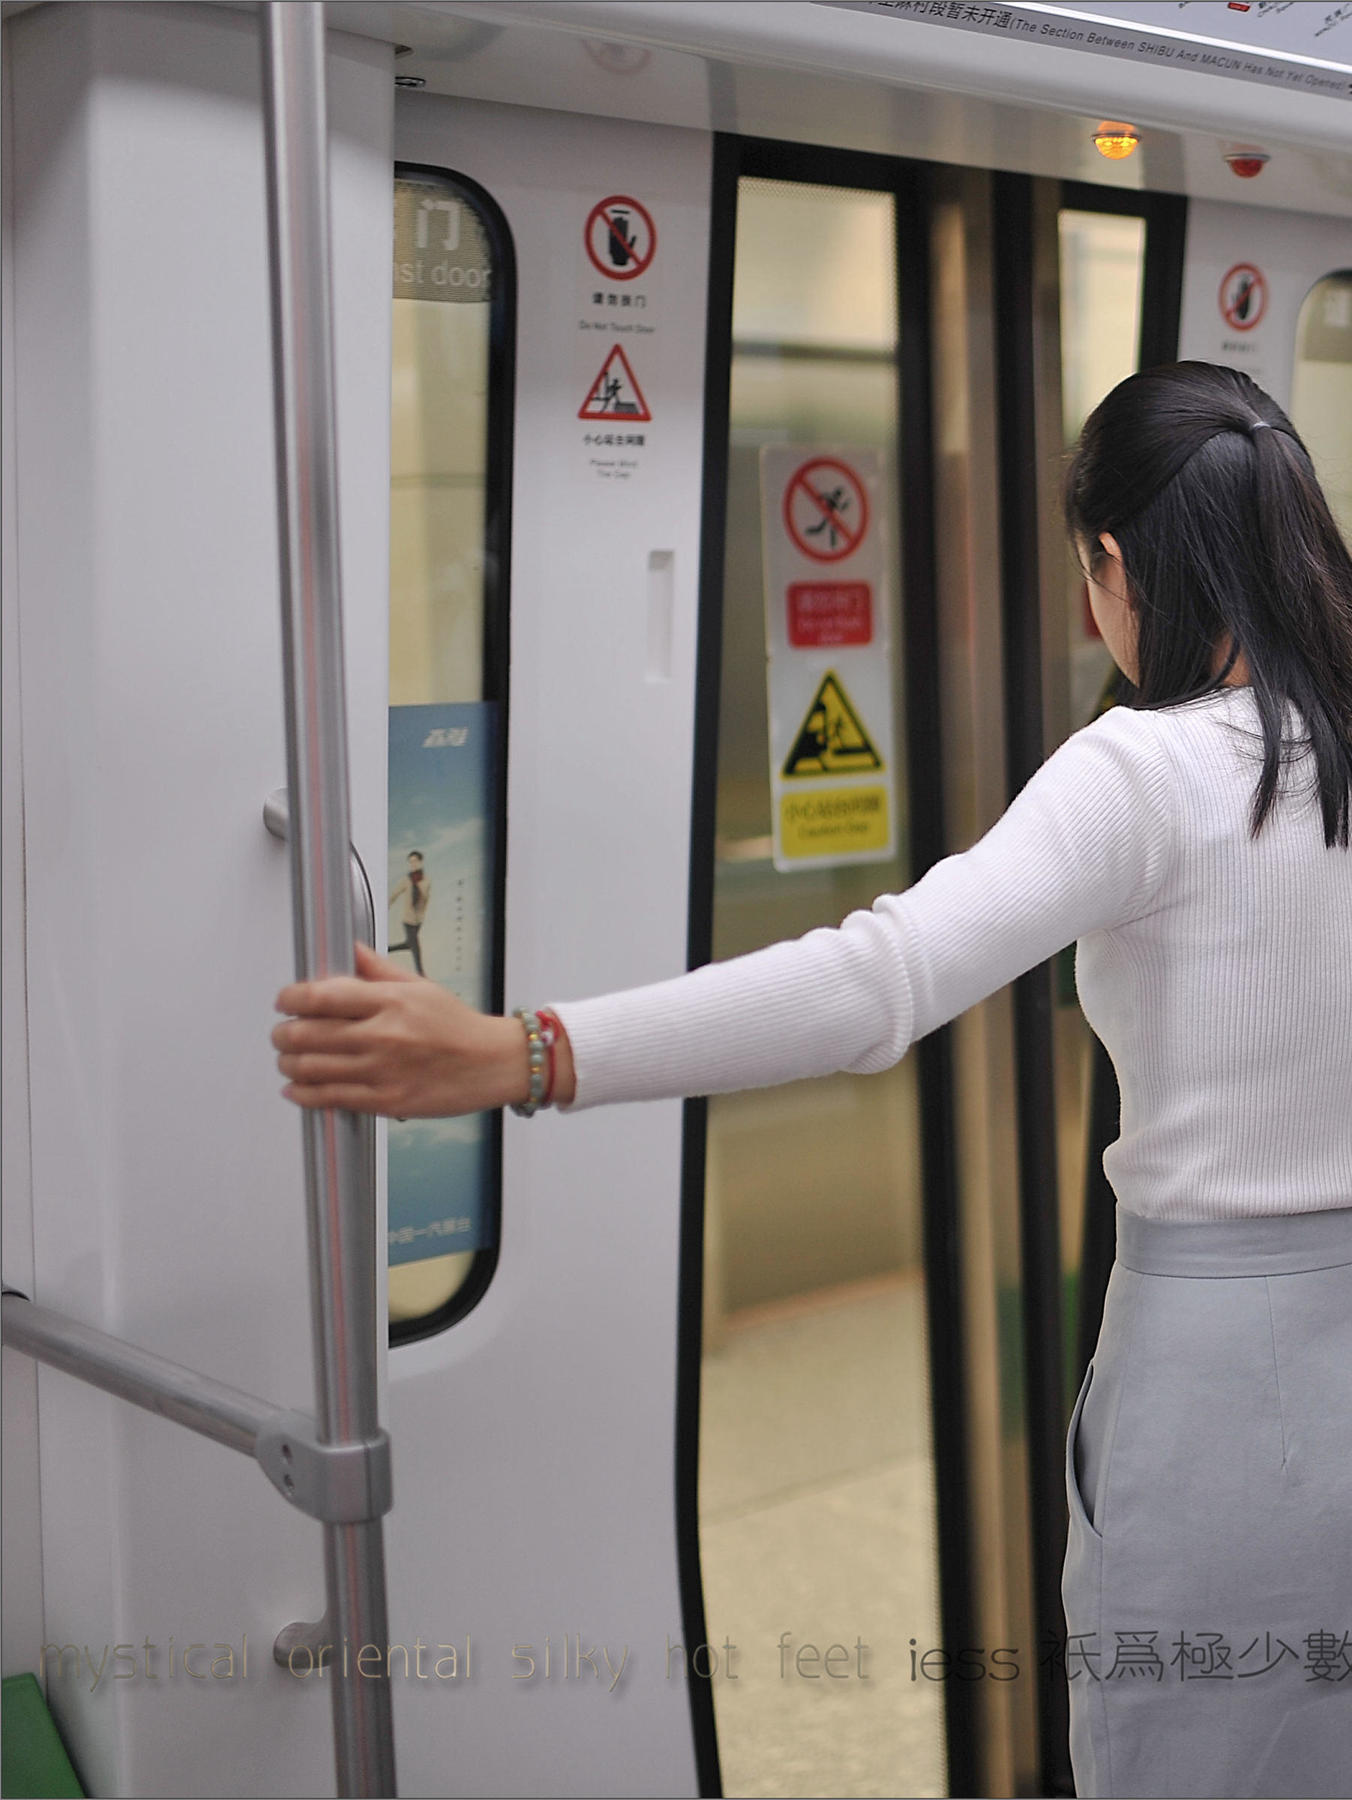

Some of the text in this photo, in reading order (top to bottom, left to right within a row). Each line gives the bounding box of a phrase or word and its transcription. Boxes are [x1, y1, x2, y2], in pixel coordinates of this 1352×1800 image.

[870, 2, 1011, 29] 村段暂未开通
[1041, 24, 1084, 41] Section
[1087, 32, 1135, 50] Between
[1138, 41, 1175, 58] SHIBU
[1176, 49, 1199, 63] And
[1201, 53, 1241, 71] MACUN
[1243, 63, 1263, 75] Has
[431, 260, 492, 289] door
